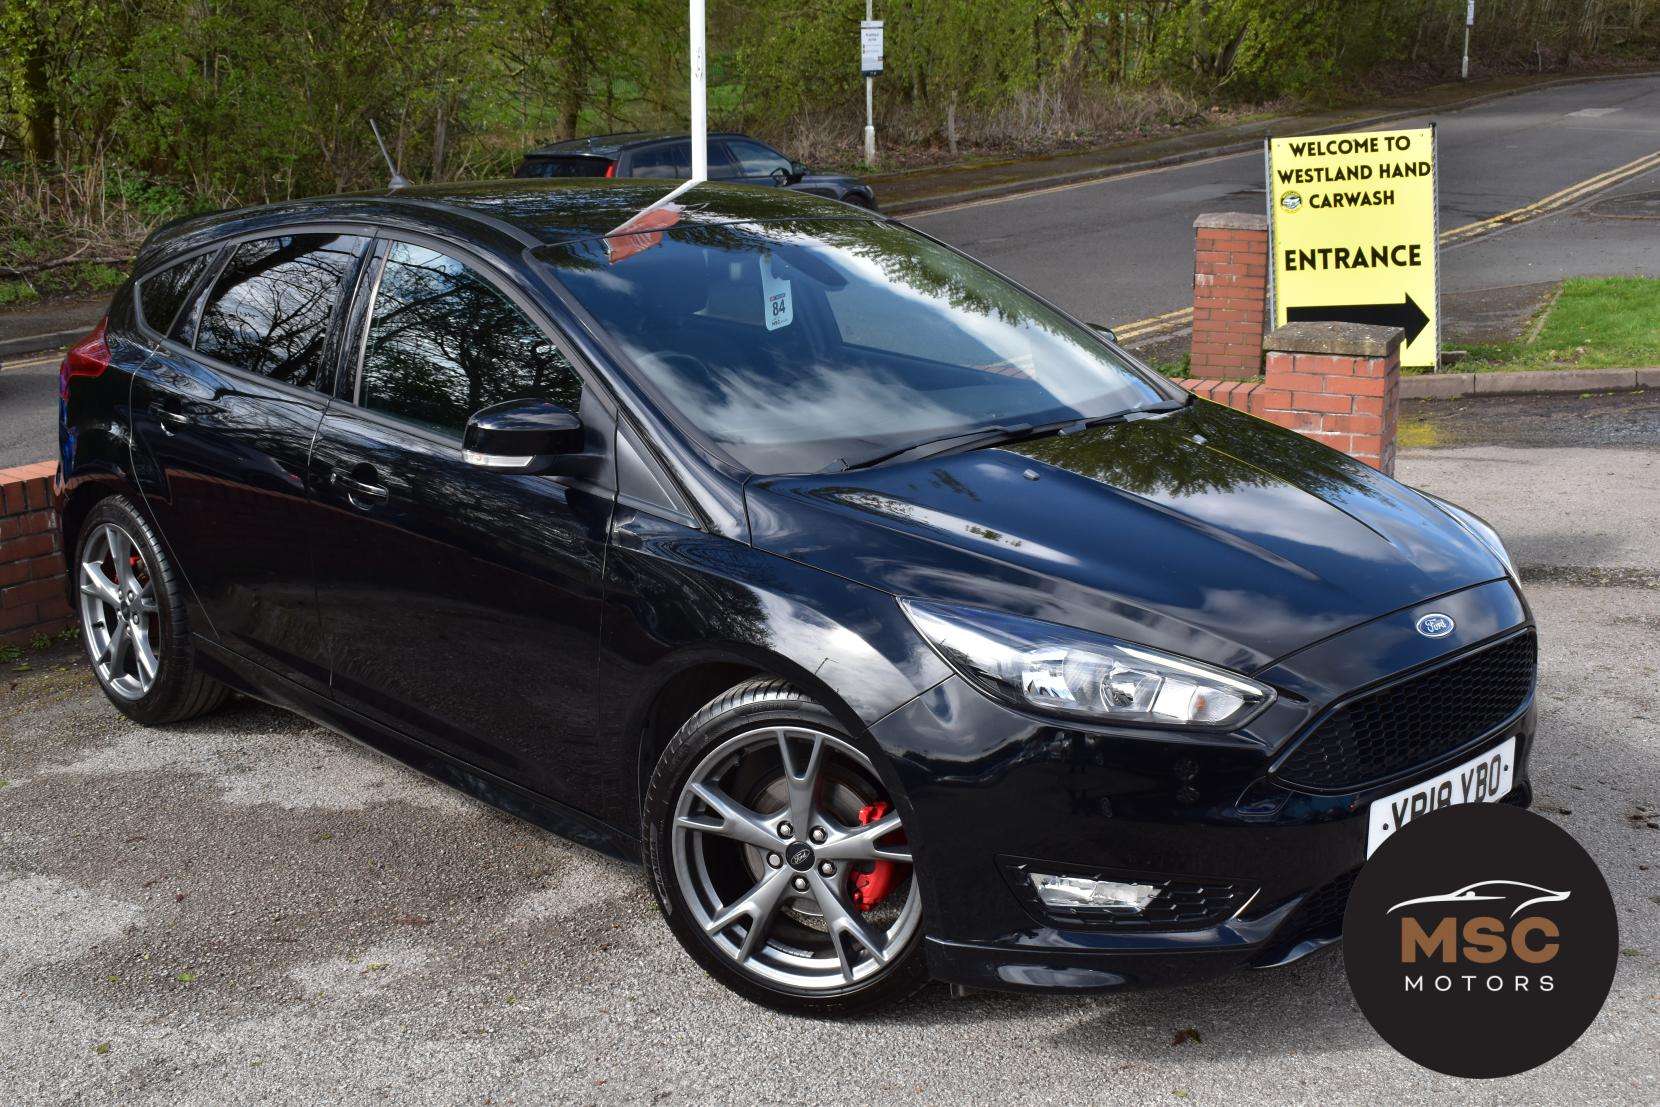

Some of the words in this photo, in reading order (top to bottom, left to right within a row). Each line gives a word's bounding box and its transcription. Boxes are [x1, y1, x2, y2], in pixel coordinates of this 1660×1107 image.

[1289, 137, 1378, 157] WELCOME
[1384, 136, 1411, 151] TO
[1278, 166, 1373, 184] WESTLAND
[1379, 162, 1431, 179] HAND
[1309, 190, 1395, 208] CARWASH
[1285, 244, 1421, 271] ENTRANCE
[773, 299, 786, 316] 84
[1425, 618, 1447, 633] Ford
